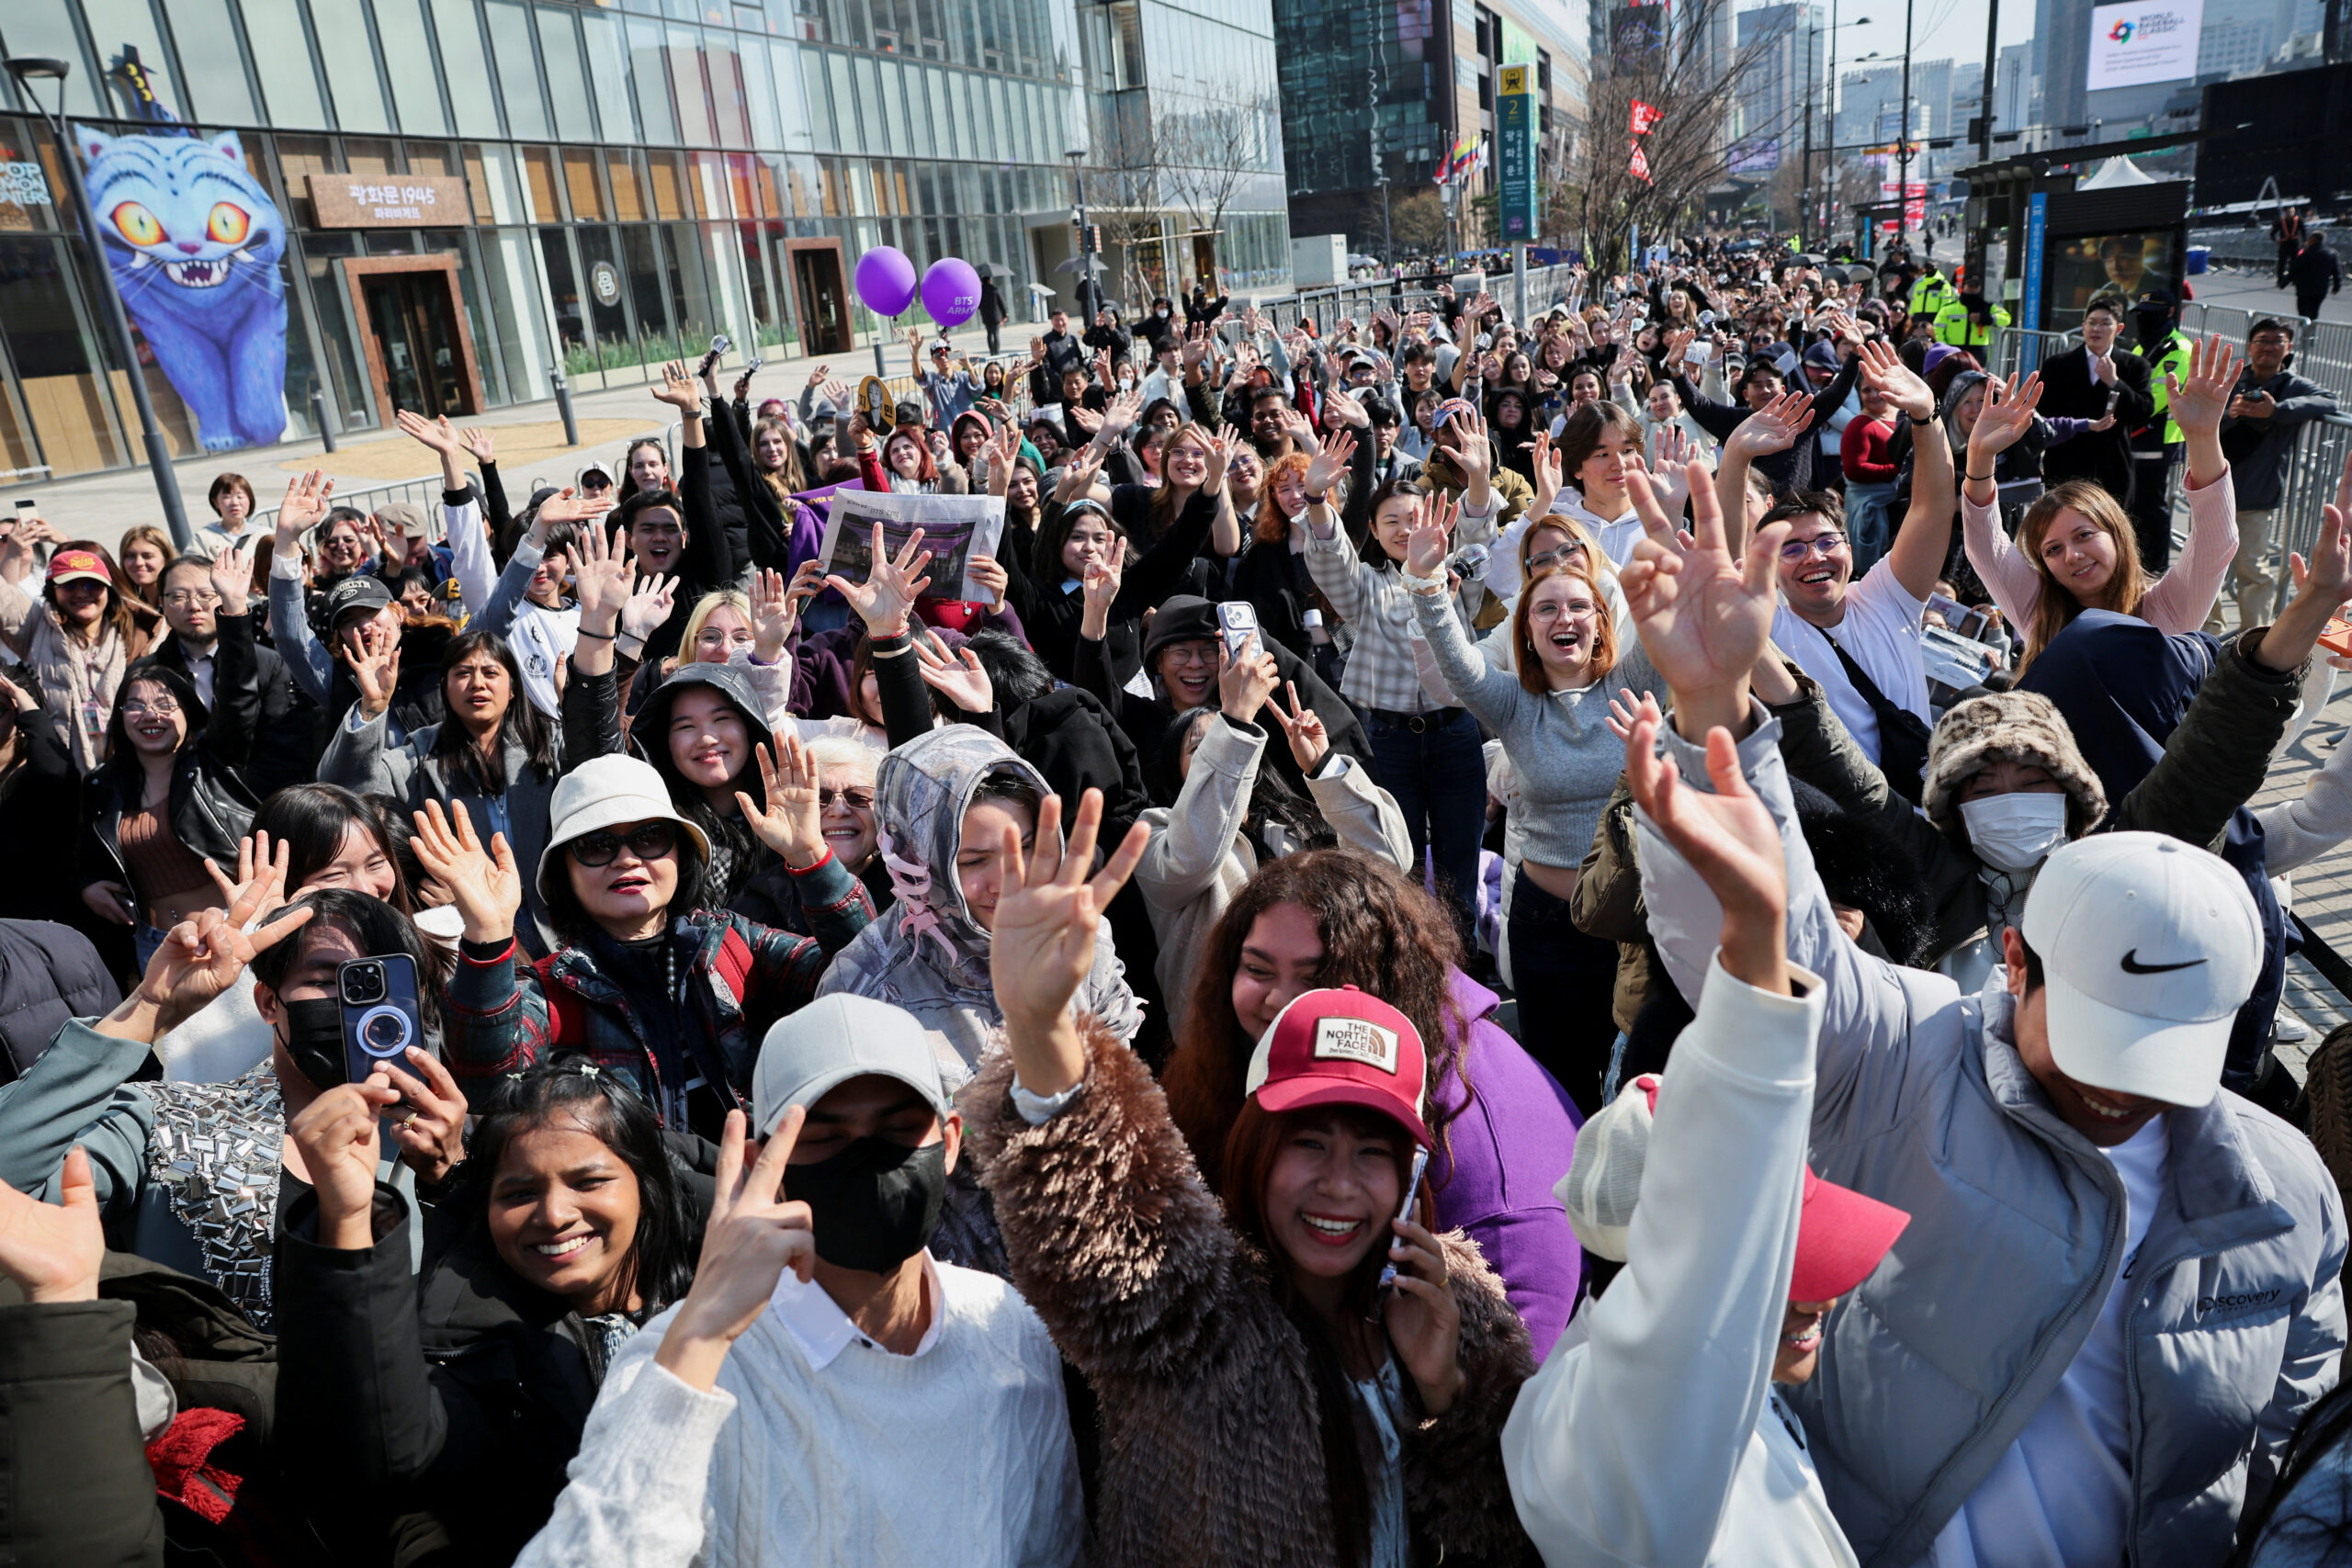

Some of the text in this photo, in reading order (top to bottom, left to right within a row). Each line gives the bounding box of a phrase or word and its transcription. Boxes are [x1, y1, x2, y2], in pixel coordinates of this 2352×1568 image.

[1509, 99, 1518, 115] 2
[1505, 130, 1516, 176] 광화문
[348, 186, 435, 206] 광화문 1945
[374, 207, 422, 220] 파리바게뜨
[955, 296, 973, 306] BTS
[947, 306, 976, 315] ARMY
[1347, 1022, 1368, 1034] THE
[1326, 1030, 1368, 1043] NORTH
[1337, 1039, 1367, 1052] FACE
[2199, 1289, 2280, 1311] Discovery
